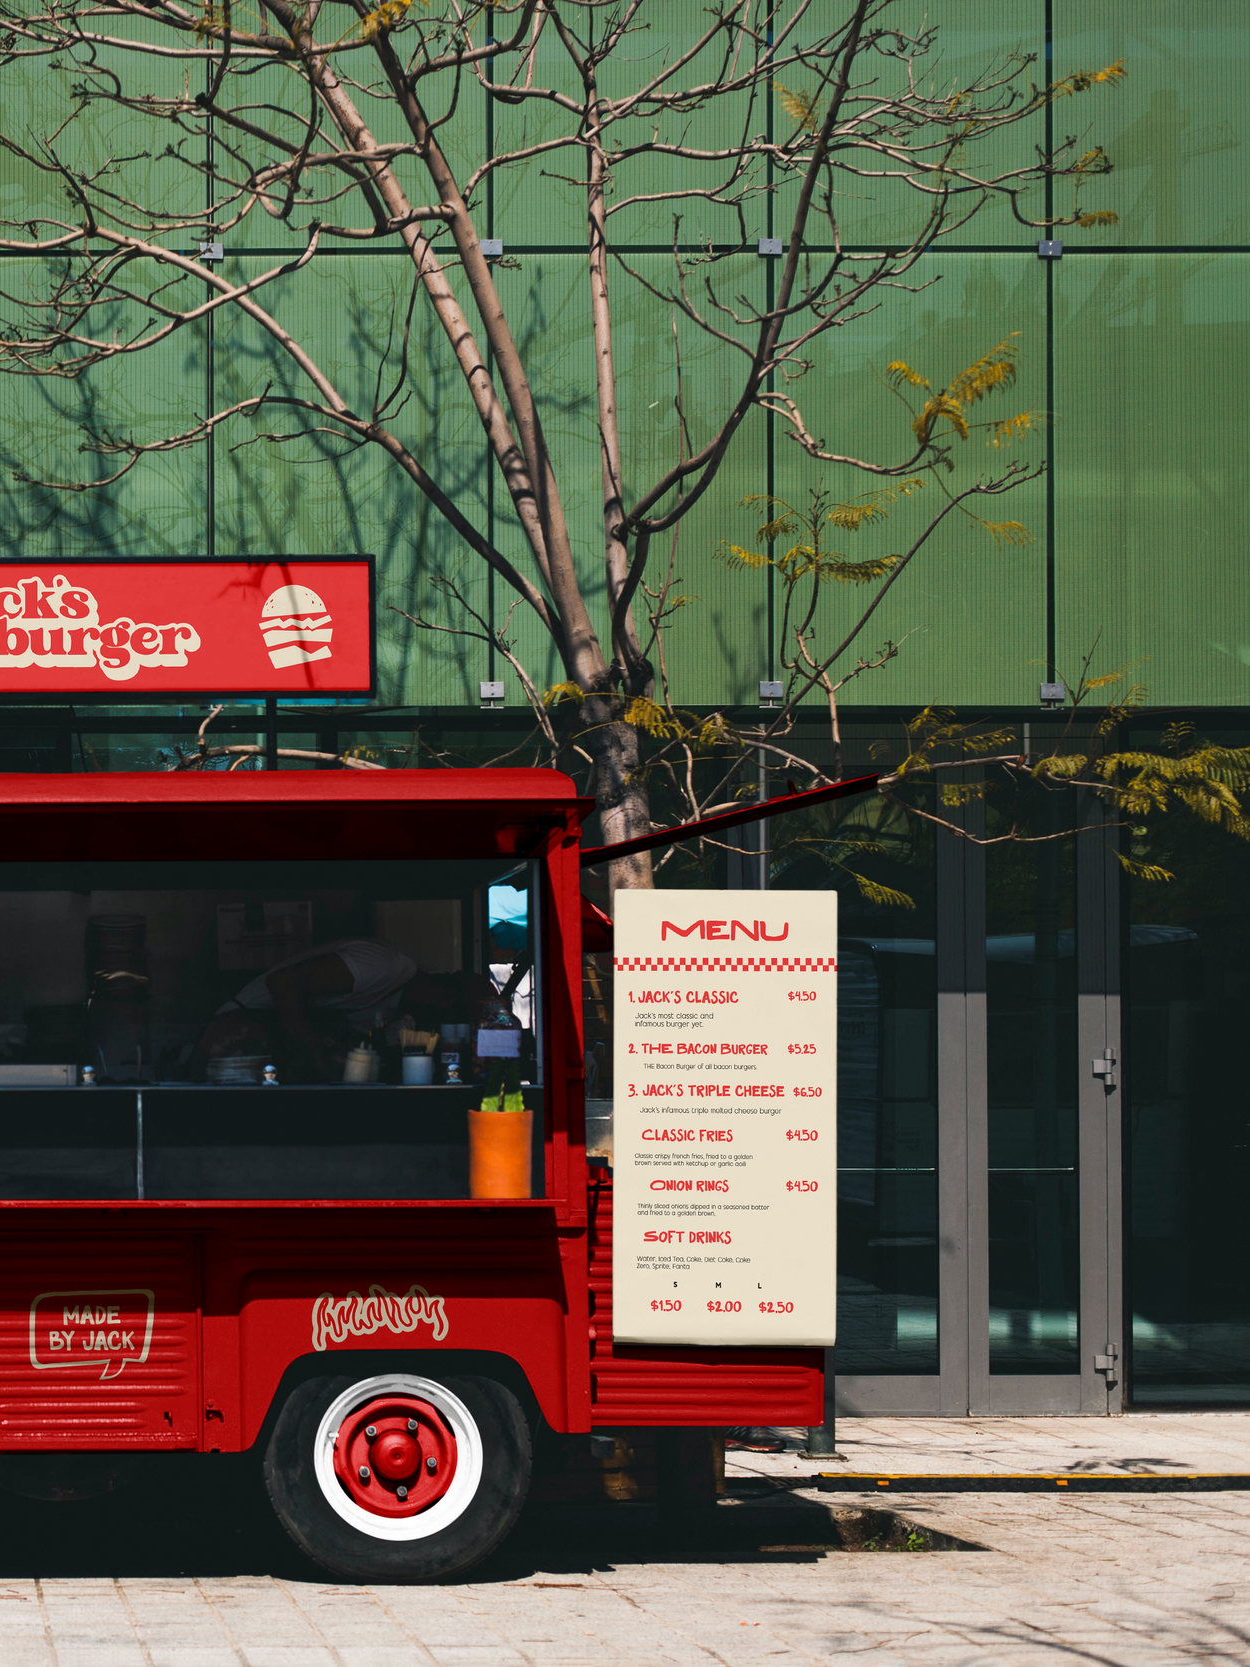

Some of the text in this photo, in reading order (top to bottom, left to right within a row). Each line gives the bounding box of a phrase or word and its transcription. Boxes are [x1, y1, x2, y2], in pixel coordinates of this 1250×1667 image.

[661, 920, 789, 941] MENU
[628, 990, 816, 1004] 1. JACK'S CLASSIC $4.50
[635, 1012, 714, 1020] Jack's most classic and
[635, 1020, 664, 1028] infamous
[666, 1020, 689, 1029] burger
[628, 1043, 816, 1055] 2. THE BACON BURGER $5.25
[676, 1063, 696, 1071] Burger
[628, 1084, 822, 1098] 3. JACK'S TRIPLE CHEESE $6.50
[640, 1106, 782, 1116] Jack's infamous triple melted cheese burger
[642, 1129, 818, 1142] CLASSIC FRIES $4.50
[655, 1153, 671, 1161] crispy
[686, 1160, 709, 1168] ketchup
[650, 1180, 818, 1193] ONION RINGS $4.50
[677, 1209, 696, 1217] golden
[690, 1203, 710, 1211] dipped
[643, 1230, 732, 1244] SOFT DRINKS
[658, 1255, 671, 1263] Iced
[704, 1255, 716, 1263] Diet
[735, 1255, 750, 1263] Coke
[651, 1300, 794, 1313] $1.50 $2.00 $2.50
[63, 1305, 121, 1326] MADE
[49, 1330, 135, 1351] BY JACK
